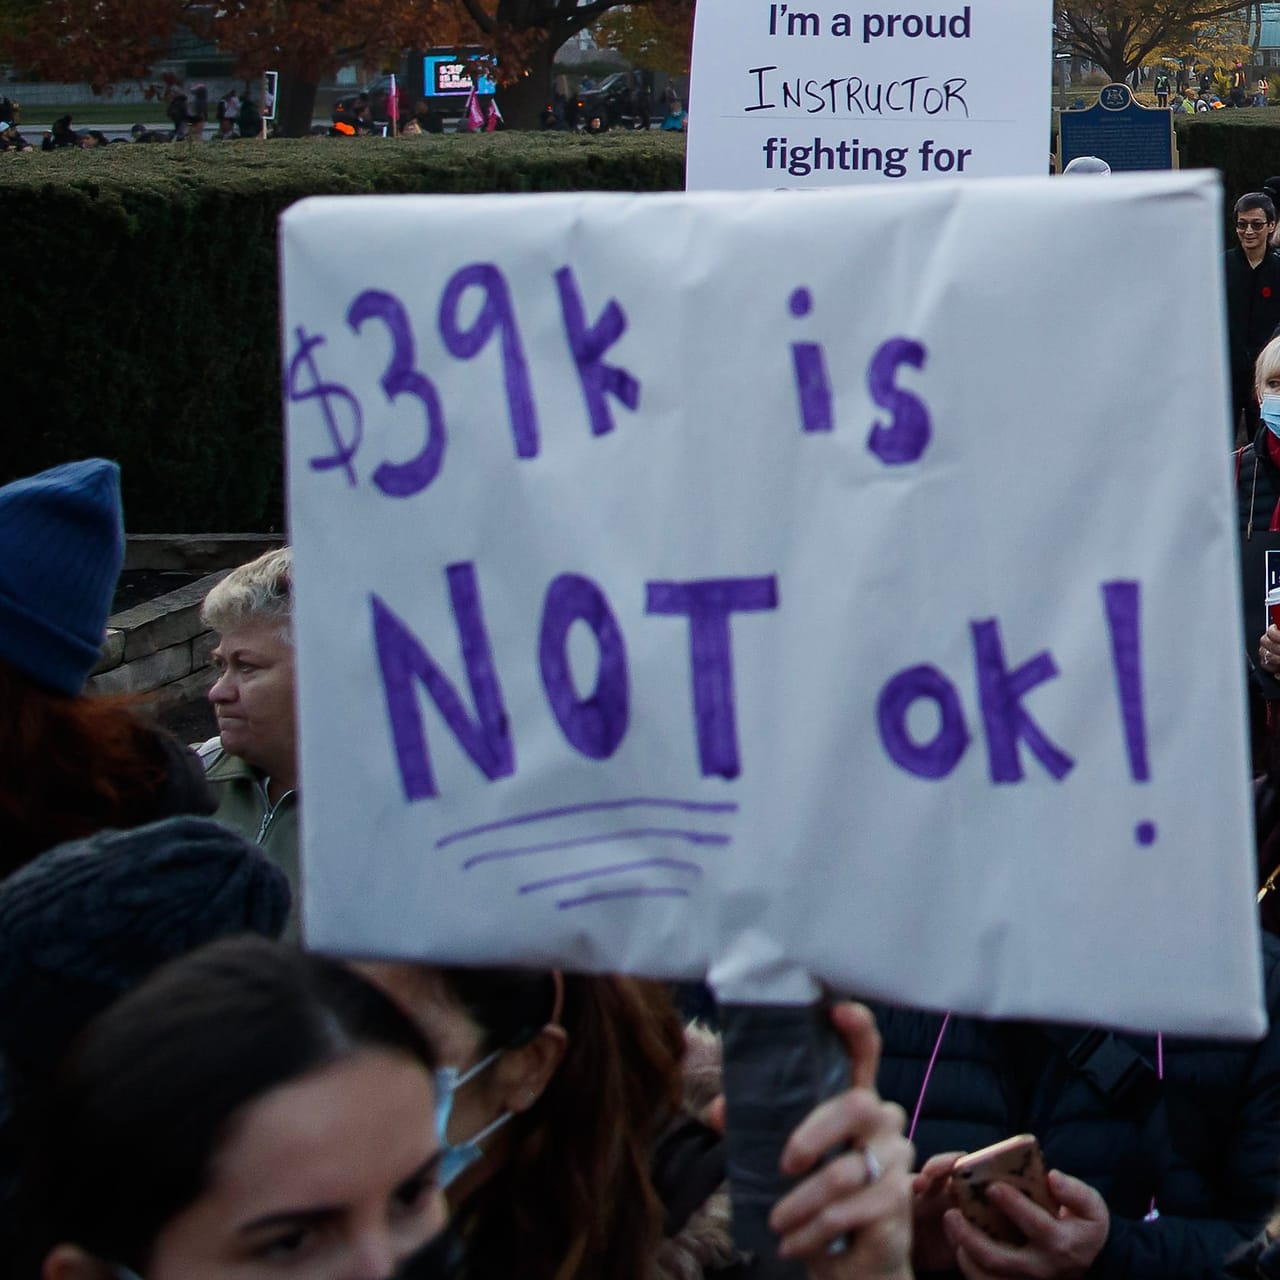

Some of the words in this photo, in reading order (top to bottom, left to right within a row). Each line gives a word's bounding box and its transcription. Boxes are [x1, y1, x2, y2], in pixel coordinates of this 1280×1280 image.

[769, 3, 821, 36] I'm
[831, 13, 851, 37] a
[862, 5, 971, 43] proud
[762, 138, 907, 177] fighting
[917, 138, 972, 172] for
[784, 286, 932, 466] is
[1271, 570, 1275, 585] I
[368, 560, 779, 803] NOT
